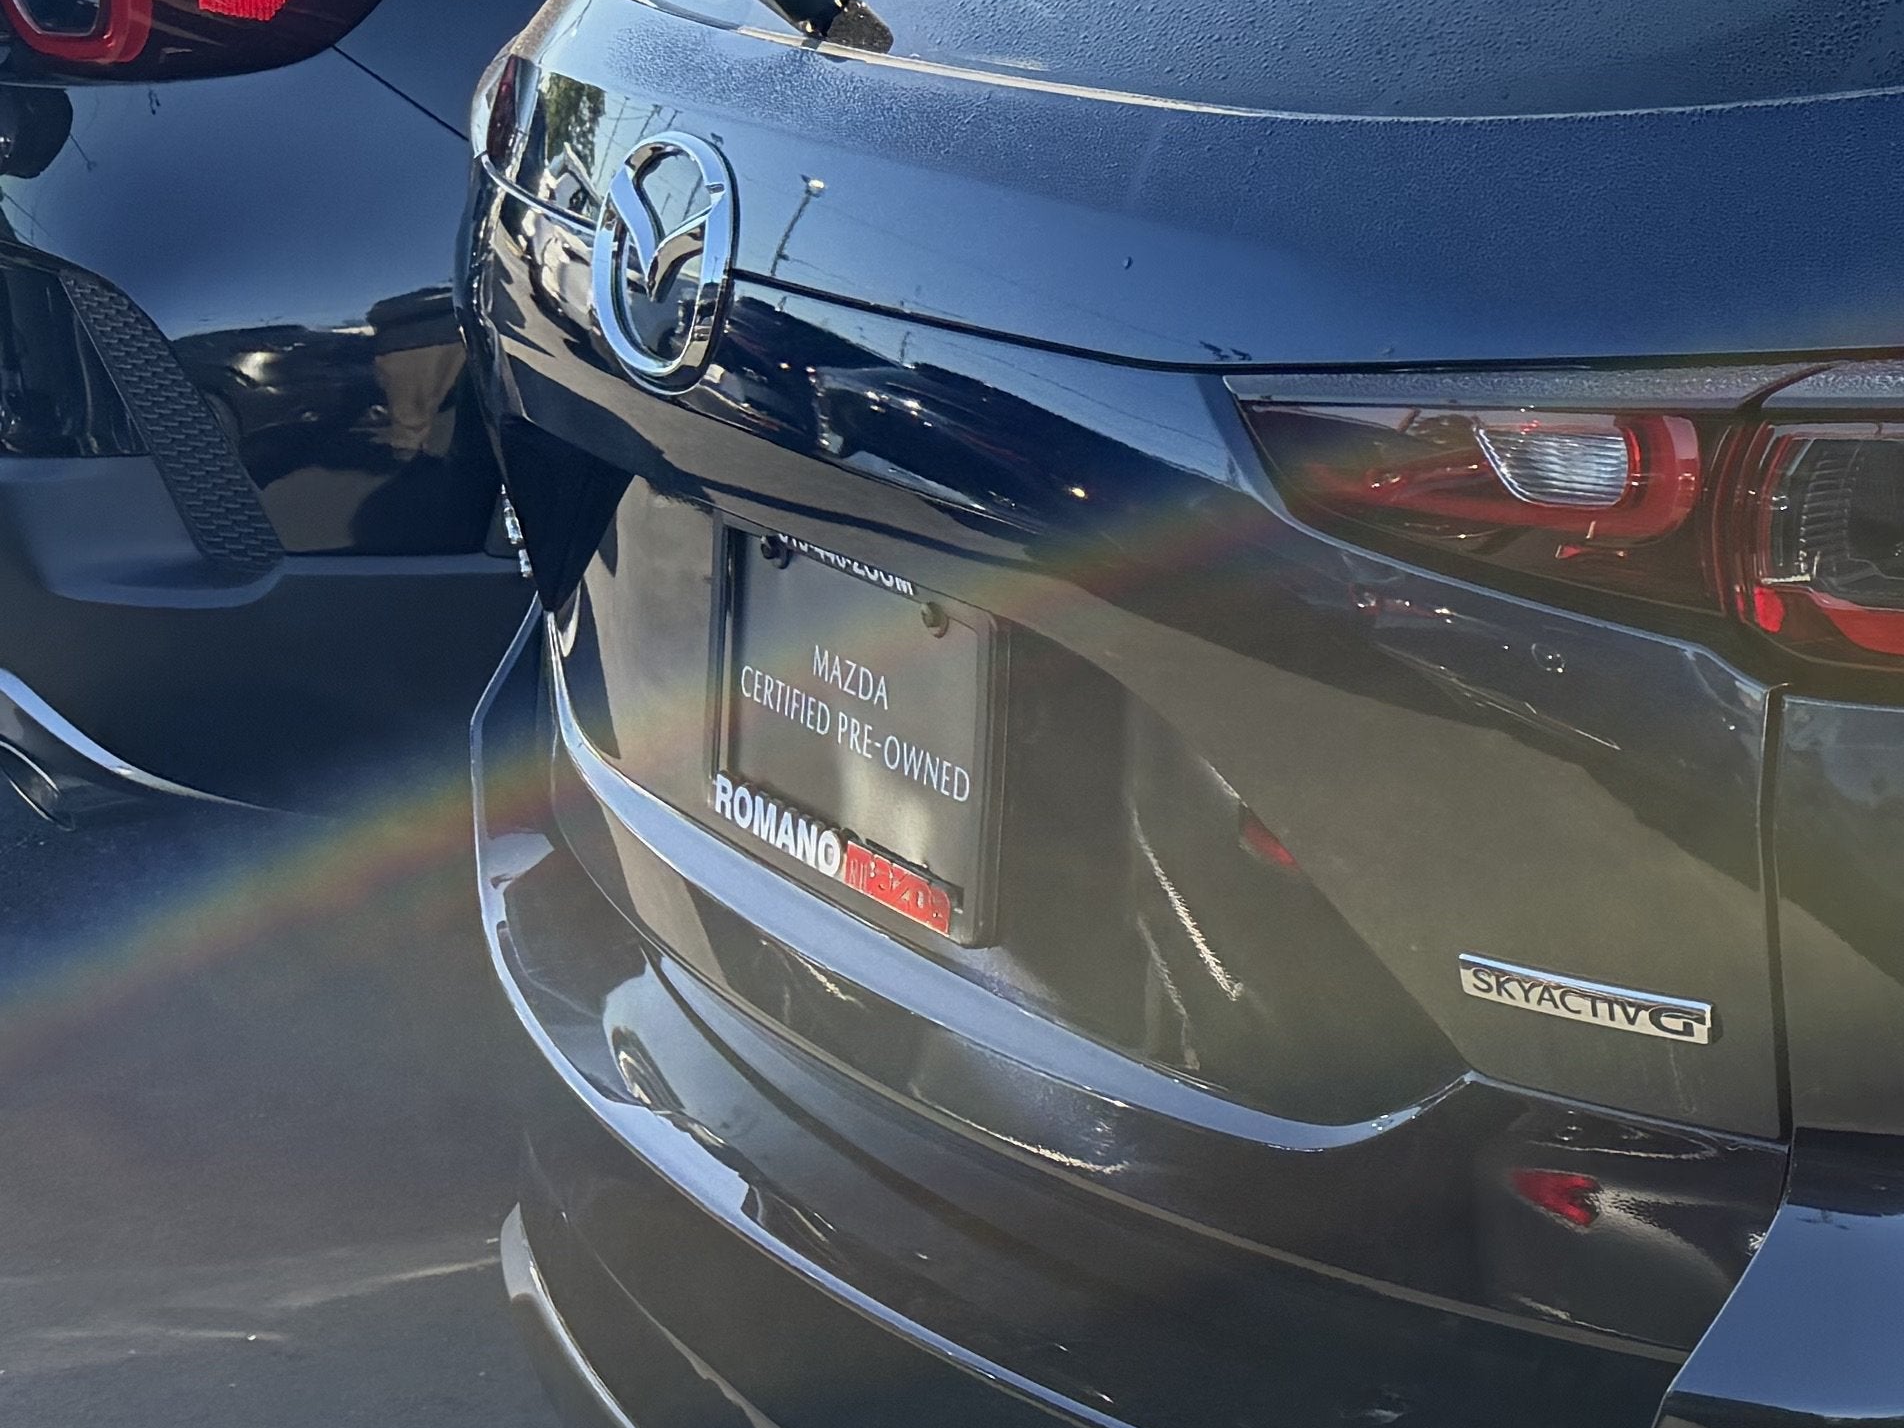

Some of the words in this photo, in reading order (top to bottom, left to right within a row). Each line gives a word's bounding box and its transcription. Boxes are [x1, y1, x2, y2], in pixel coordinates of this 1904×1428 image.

[812, 644, 889, 711] MAZDA
[740, 665, 830, 736] CERTIFIED
[837, 711, 970, 803] PRE-OWNED
[713, 773, 842, 875] ROMANO
